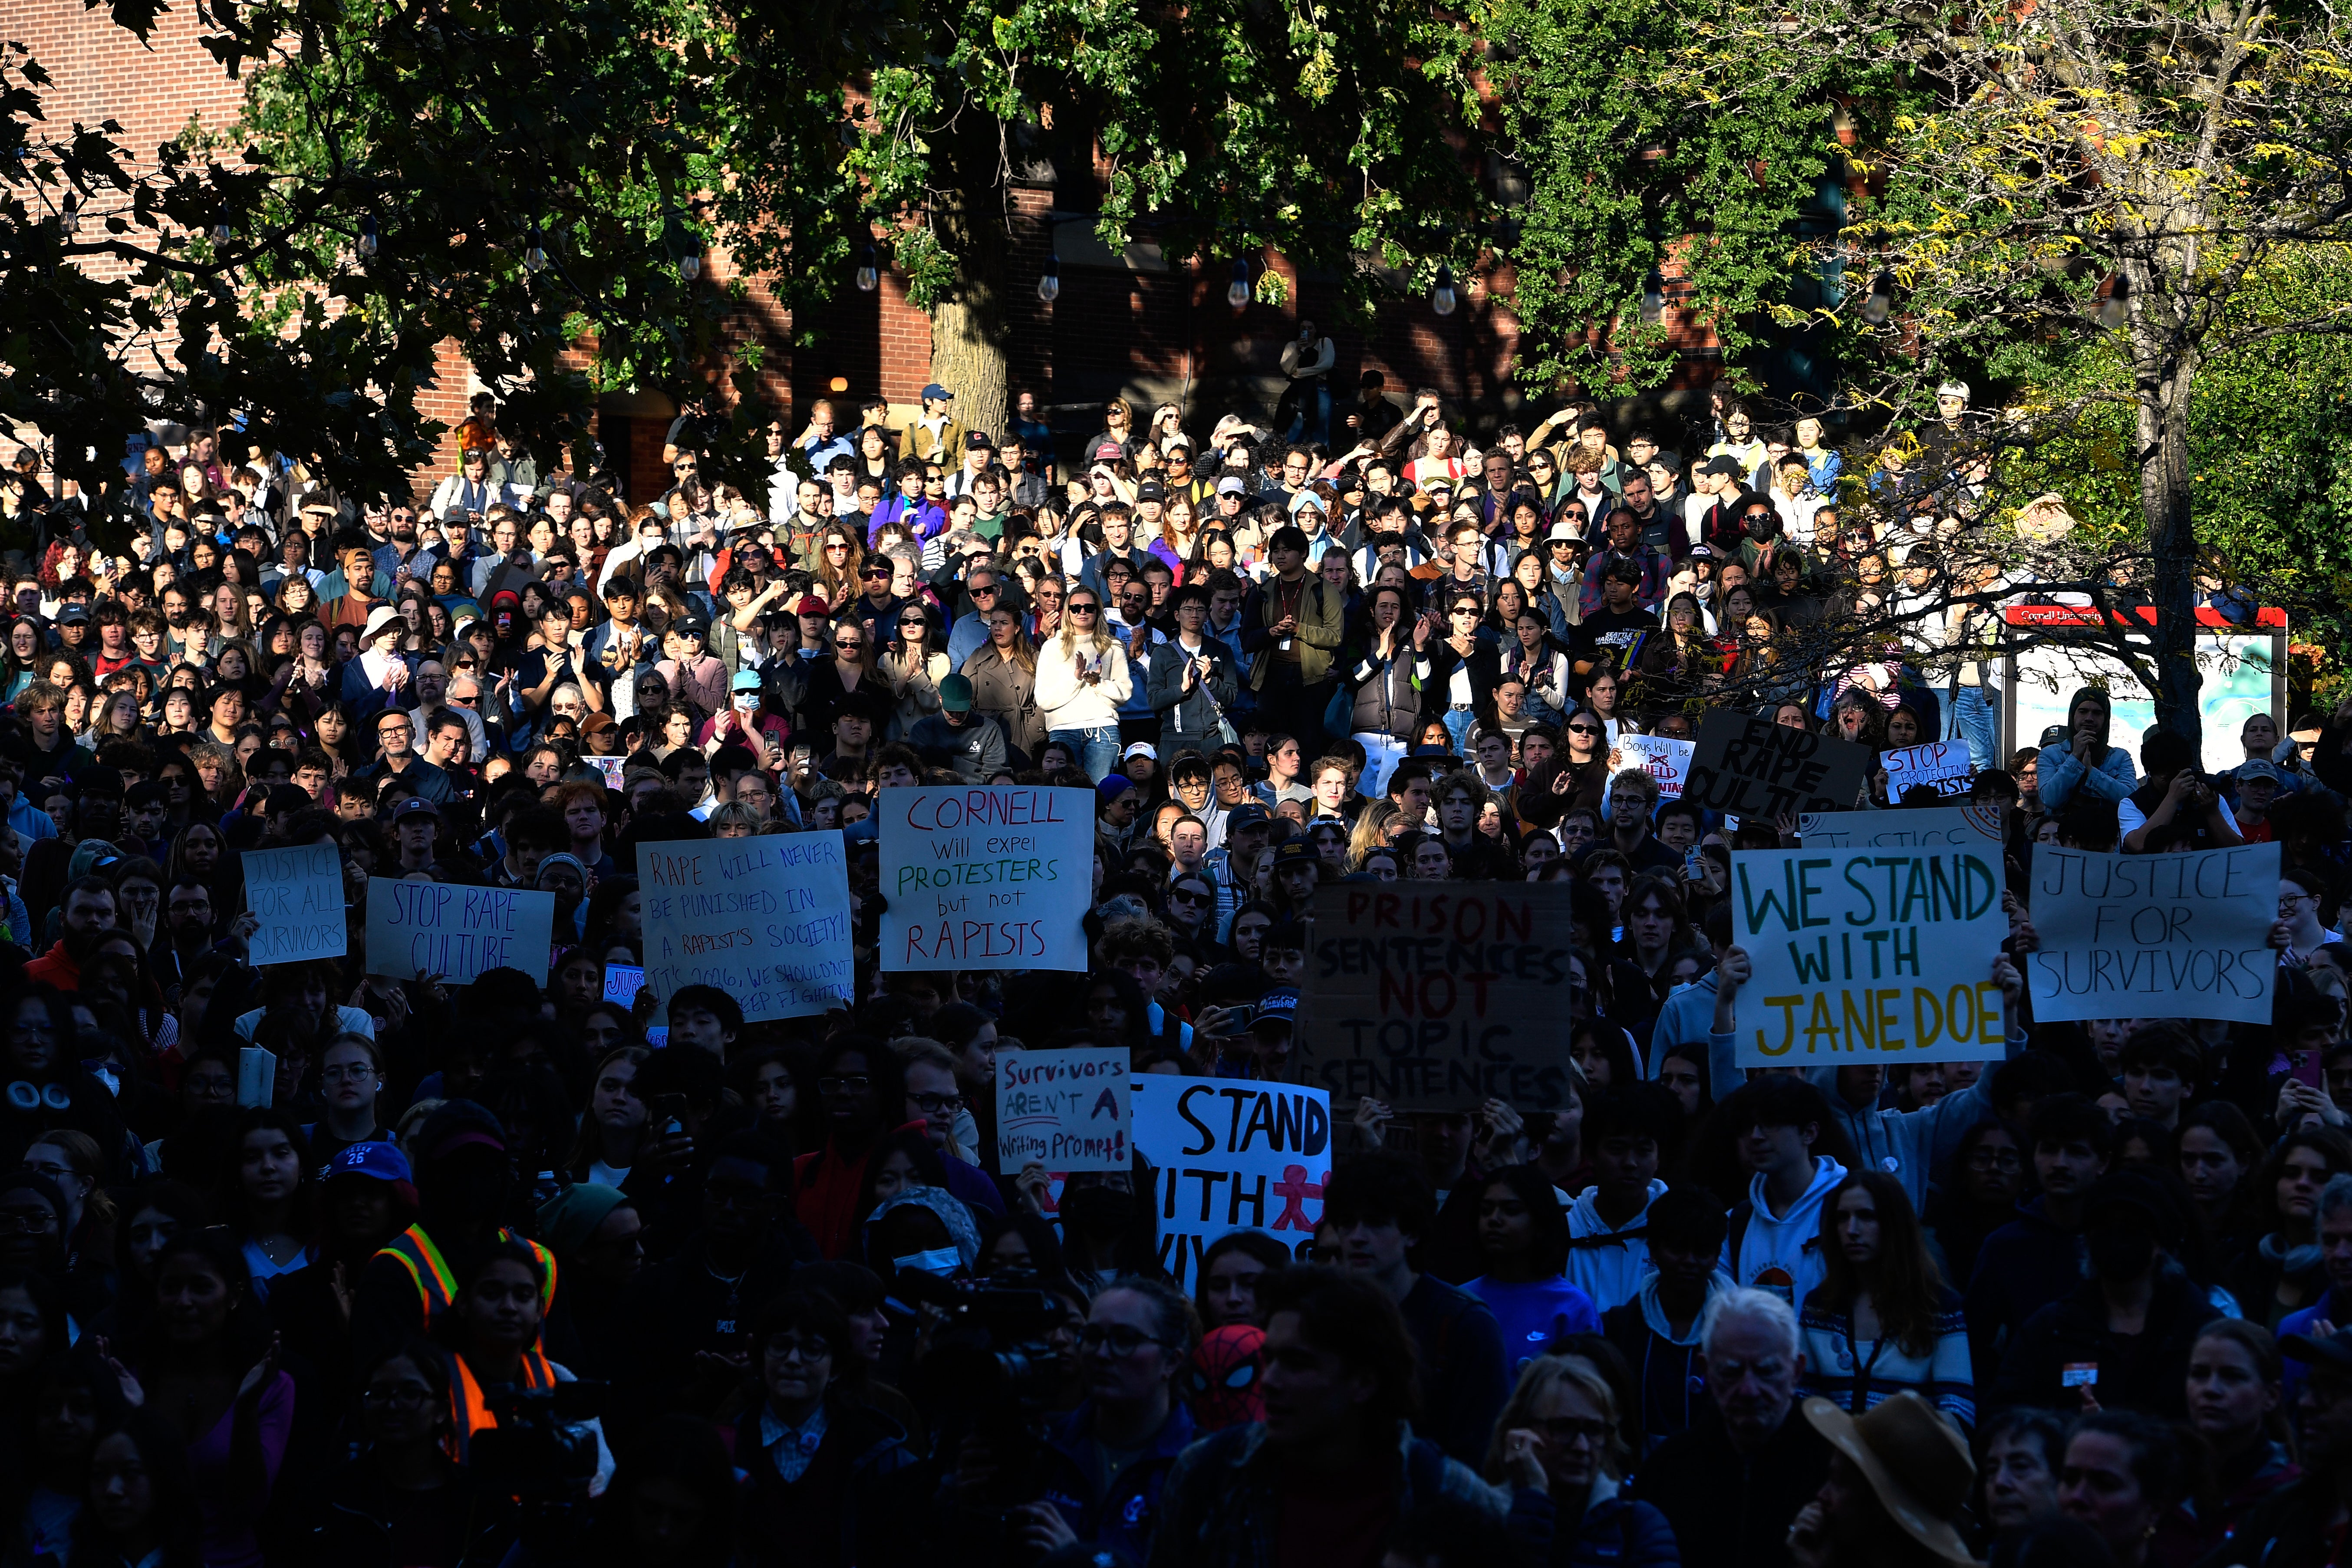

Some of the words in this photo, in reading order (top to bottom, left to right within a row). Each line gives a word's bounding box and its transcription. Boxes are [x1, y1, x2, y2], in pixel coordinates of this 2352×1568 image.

[2021, 610, 2055, 620] Cornell
[2057, 610, 2103, 623] University
[1623, 735, 1651, 756] Boys
[1678, 745, 1690, 757] be
[1743, 718, 1819, 759] END
[1886, 743, 1947, 772] STOP
[1719, 738, 1831, 794] RAPE
[1901, 764, 1970, 784] PROTECTING
[907, 790, 1064, 831] CORNELL
[650, 852, 703, 886] RAPE
[718, 850, 772, 880] WILL
[780, 842, 837, 869] NEVER
[987, 836, 1035, 853] expel
[246, 846, 338, 885] JUSTICE
[898, 858, 1058, 896] PROTESTERS
[2043, 849, 2251, 899] JUSTICE
[251, 886, 292, 917] FOR
[301, 884, 341, 915] ALL
[387, 883, 452, 928] STOP
[464, 888, 520, 932] RAPE
[649, 898, 672, 919] BE
[680, 890, 777, 918] PUNISHED
[784, 888, 815, 915] IN
[938, 894, 970, 918] but
[989, 889, 1026, 908] not
[1736, 858, 1832, 935] WE
[1844, 854, 1996, 926] STAND
[662, 936, 672, 959] A
[682, 928, 753, 955] RAPIST'S
[767, 911, 845, 947] SOCIETY!
[1347, 892, 1532, 945] PRISON
[2094, 905, 2193, 944] FOR
[254, 922, 344, 959] SURVIVORS.
[411, 932, 513, 978] CULTURE
[906, 920, 1046, 964] RAPISTS
[1316, 936, 1571, 985] SENTENCES
[1788, 926, 1920, 985] WITH
[747, 965, 771, 989] WE
[1379, 968, 1503, 1019] NOT
[2037, 949, 2264, 999] SURVIVORS
[1756, 988, 1906, 1056] JANE
[1912, 981, 2006, 1049] DOE
[1339, 1019, 1514, 1063] TOPIC
[1005, 1059, 1123, 1089] Survivors
[1320, 1057, 1565, 1107] SENTENCES
[1005, 1091, 1083, 1117] AREN'T
[1091, 1088, 1119, 1120] A
[1177, 1084, 1328, 1156] STAND
[347, 1152, 365, 1165] 26
[999, 1134, 1047, 1159] Writing
[1150, 1166, 1266, 1227] ITH
